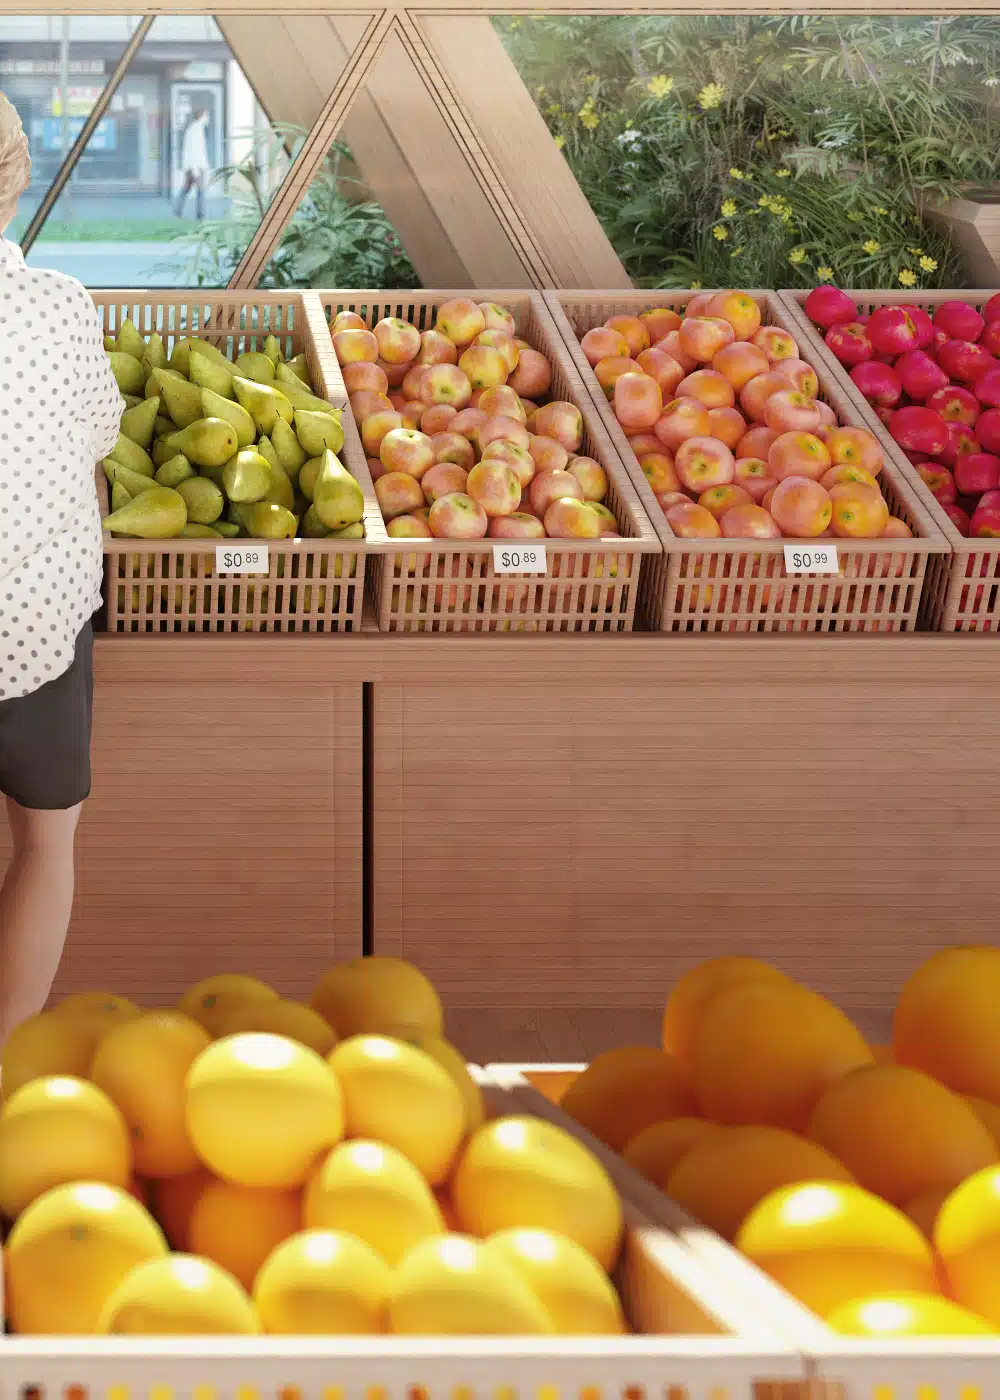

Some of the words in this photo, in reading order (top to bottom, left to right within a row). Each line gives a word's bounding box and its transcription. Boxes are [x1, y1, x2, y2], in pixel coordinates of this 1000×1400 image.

[223, 552, 259, 569] $0.89
[501, 552, 537, 569] $0.89
[792, 552, 828, 569] $0.99
